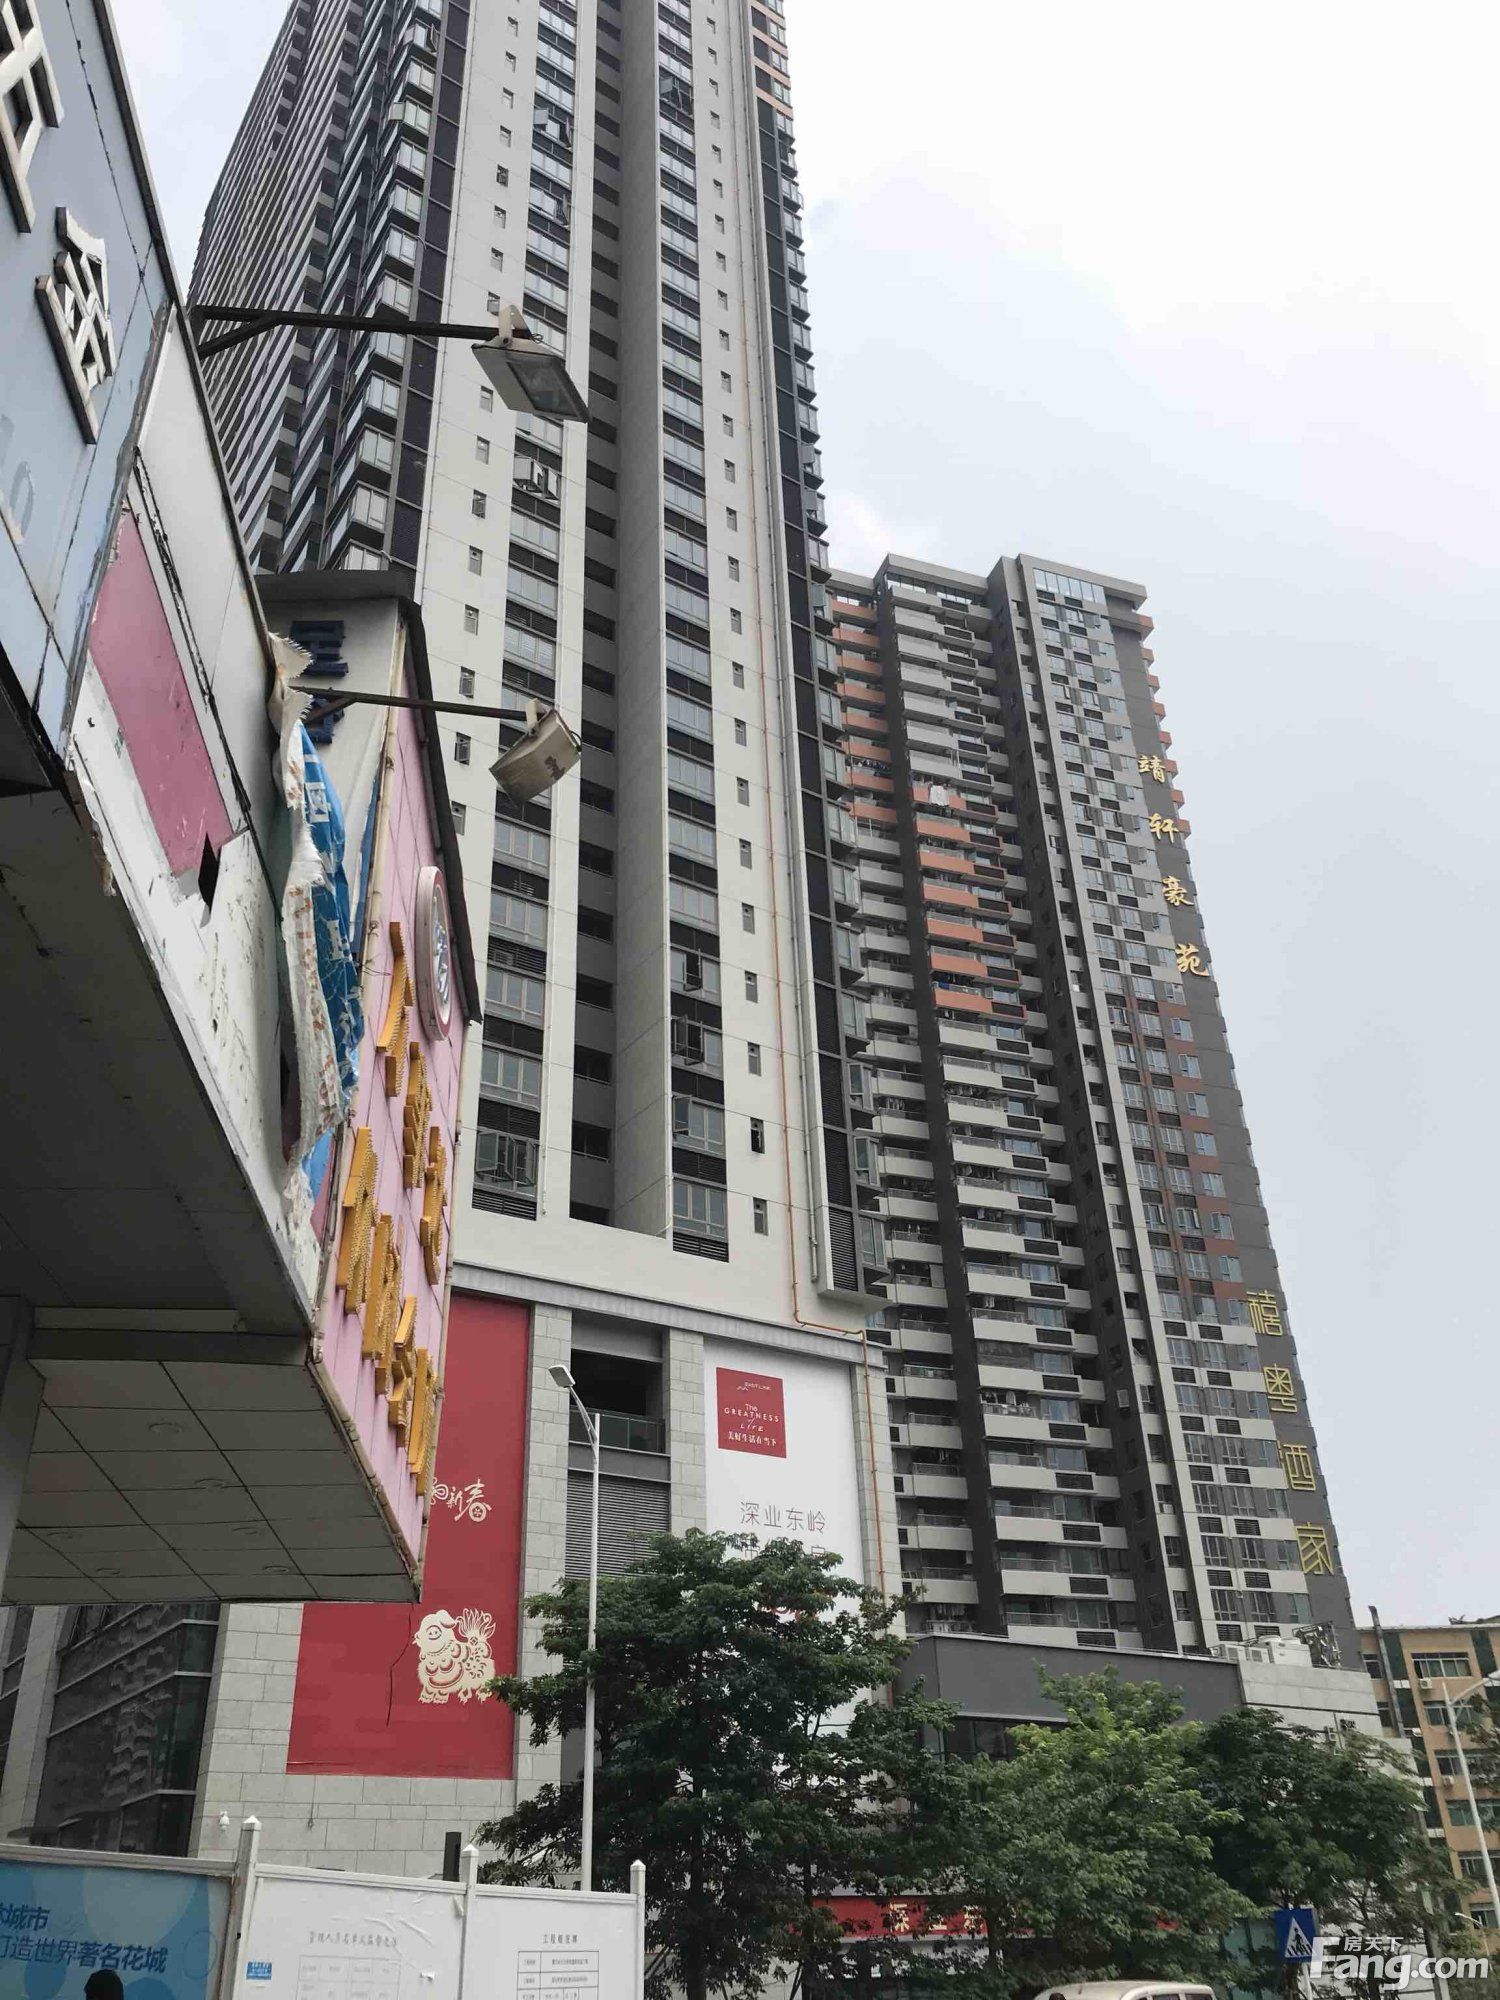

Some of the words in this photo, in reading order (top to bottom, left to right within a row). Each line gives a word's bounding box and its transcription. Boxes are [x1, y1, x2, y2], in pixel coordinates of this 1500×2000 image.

[1138, 755, 1209, 976] 靖轩豪苑
[724, 1407, 780, 1422] GREATNESS
[1246, 1290, 1335, 1576] 禧粤酒家
[740, 1501, 826, 1534] 深业东岭
